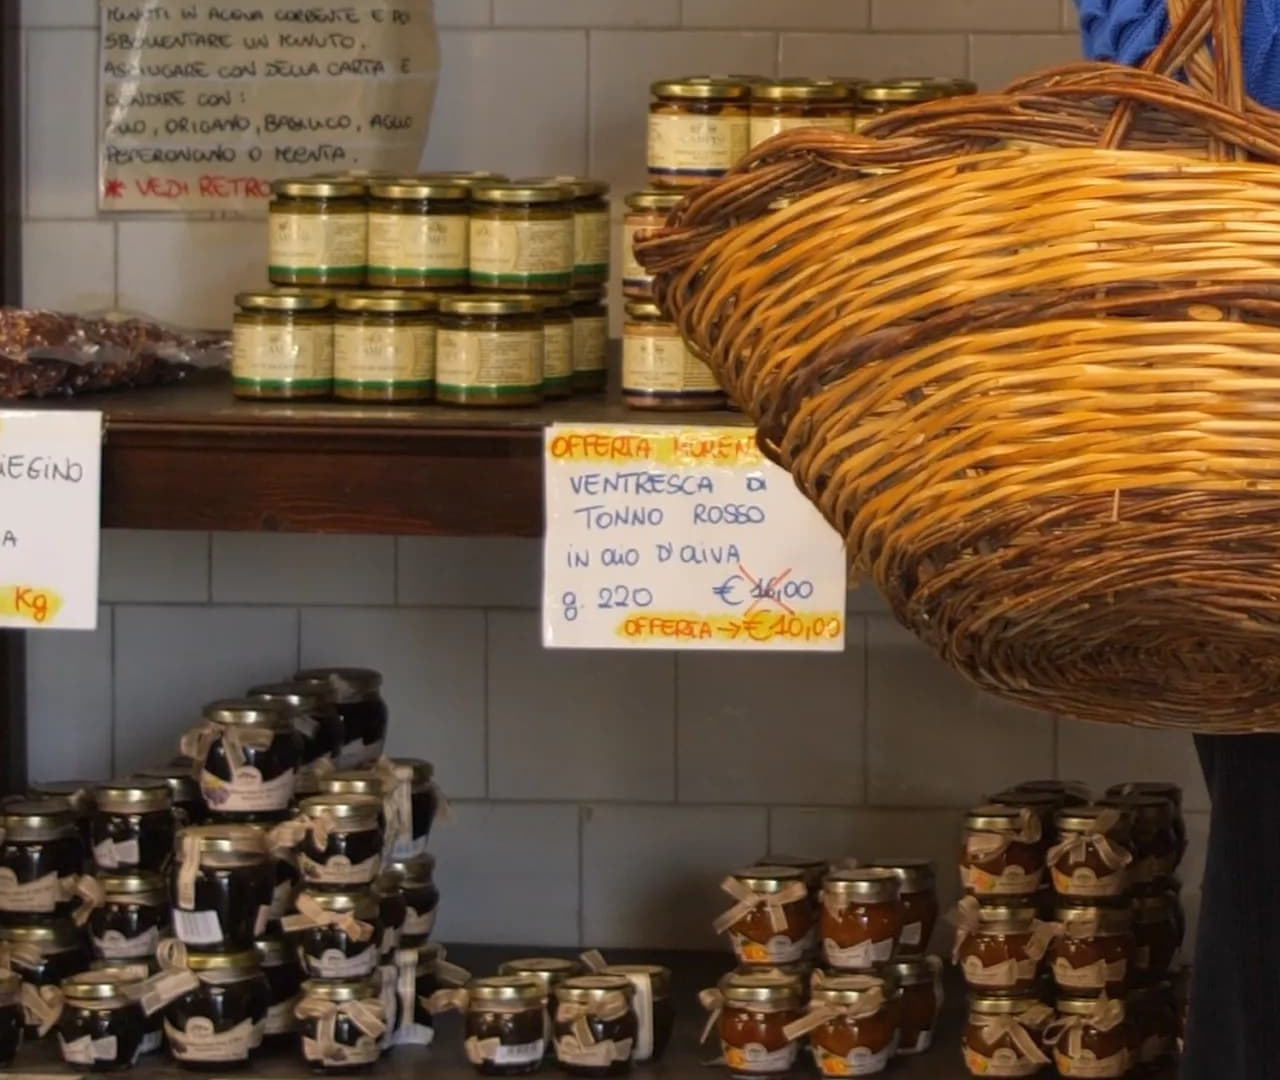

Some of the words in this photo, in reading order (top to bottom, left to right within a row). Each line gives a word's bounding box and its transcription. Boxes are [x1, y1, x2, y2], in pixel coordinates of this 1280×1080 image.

[371, 8, 385, 21] E
[242, 34, 269, 50] UN
[217, 60, 256, 78] CON
[266, 60, 319, 78] DELLA
[327, 58, 385, 76] CARTA
[401, 58, 411, 74] E
[248, 147, 262, 162] O
[136, 177, 188, 199] VEDI
[551, 434, 651, 459] OFFERTA
[570, 472, 713, 495] VENTRESCA
[574, 505, 664, 529] TONNO
[694, 503, 765, 524] ROSSO
[598, 585, 653, 610] 220
[712, 574, 745, 605] €
[750, 576, 814, 602] 16,00
[15, 585, 47, 623] Kg
[625, 617, 712, 640] OFFERTA
[744, 609, 772, 640] €
[770, 616, 841, 641] 10,00
